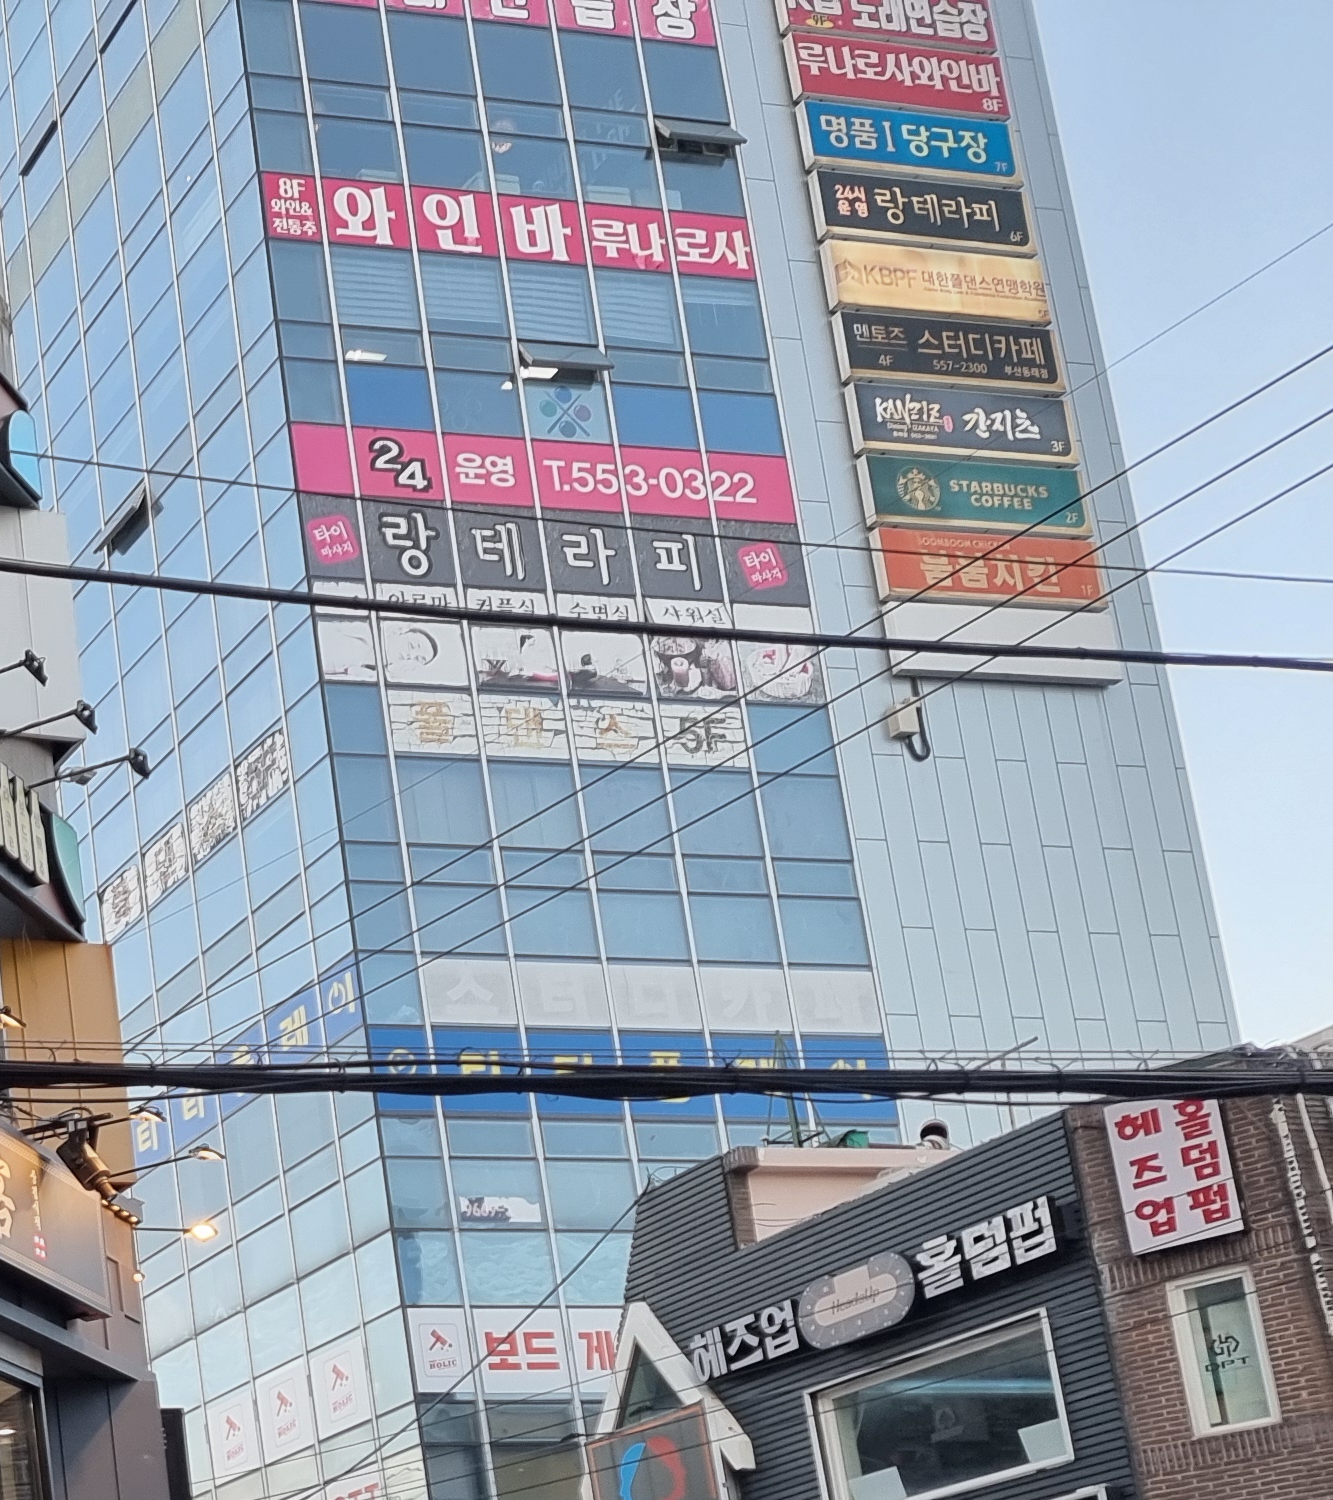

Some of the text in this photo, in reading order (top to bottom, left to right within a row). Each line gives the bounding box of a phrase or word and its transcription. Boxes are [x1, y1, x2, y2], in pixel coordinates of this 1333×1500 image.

[797, 41, 1001, 98] 루나로사와인바
[981, 98, 1004, 113] 8F
[819, 114, 988, 164] 명품 당구장
[277, 176, 306, 198] 8F
[834, 184, 867, 202] 24시
[837, 200, 870, 218] 운영
[873, 186, 1000, 232] 랑테라피
[333, 185, 751, 271] 와인바 루나로사
[1009, 230, 1024, 243] 6F
[862, 263, 918, 289] KBPF
[917, 330, 1045, 366] 스터디카페
[878, 354, 894, 368] 4F
[932, 359, 988, 374] 557-2300
[1050, 440, 1066, 453] 3F
[370, 438, 431, 492] 24
[455, 452, 517, 487] 운영
[949, 479, 1049, 498] STARBUCKS
[970, 495, 1033, 510] COFFEE
[1065, 511, 1079, 524] 2F
[312, 522, 348, 543] 타이
[380, 511, 704, 592] 랑테라피
[742, 547, 778, 569] 타이
[1113, 1107, 1178, 1238] 헤즈업
[1172, 1098, 1232, 1225] 홀덤펍
[916, 1194, 1060, 1300] 홀덤펍
[689, 1298, 801, 1384] 헤즈업
